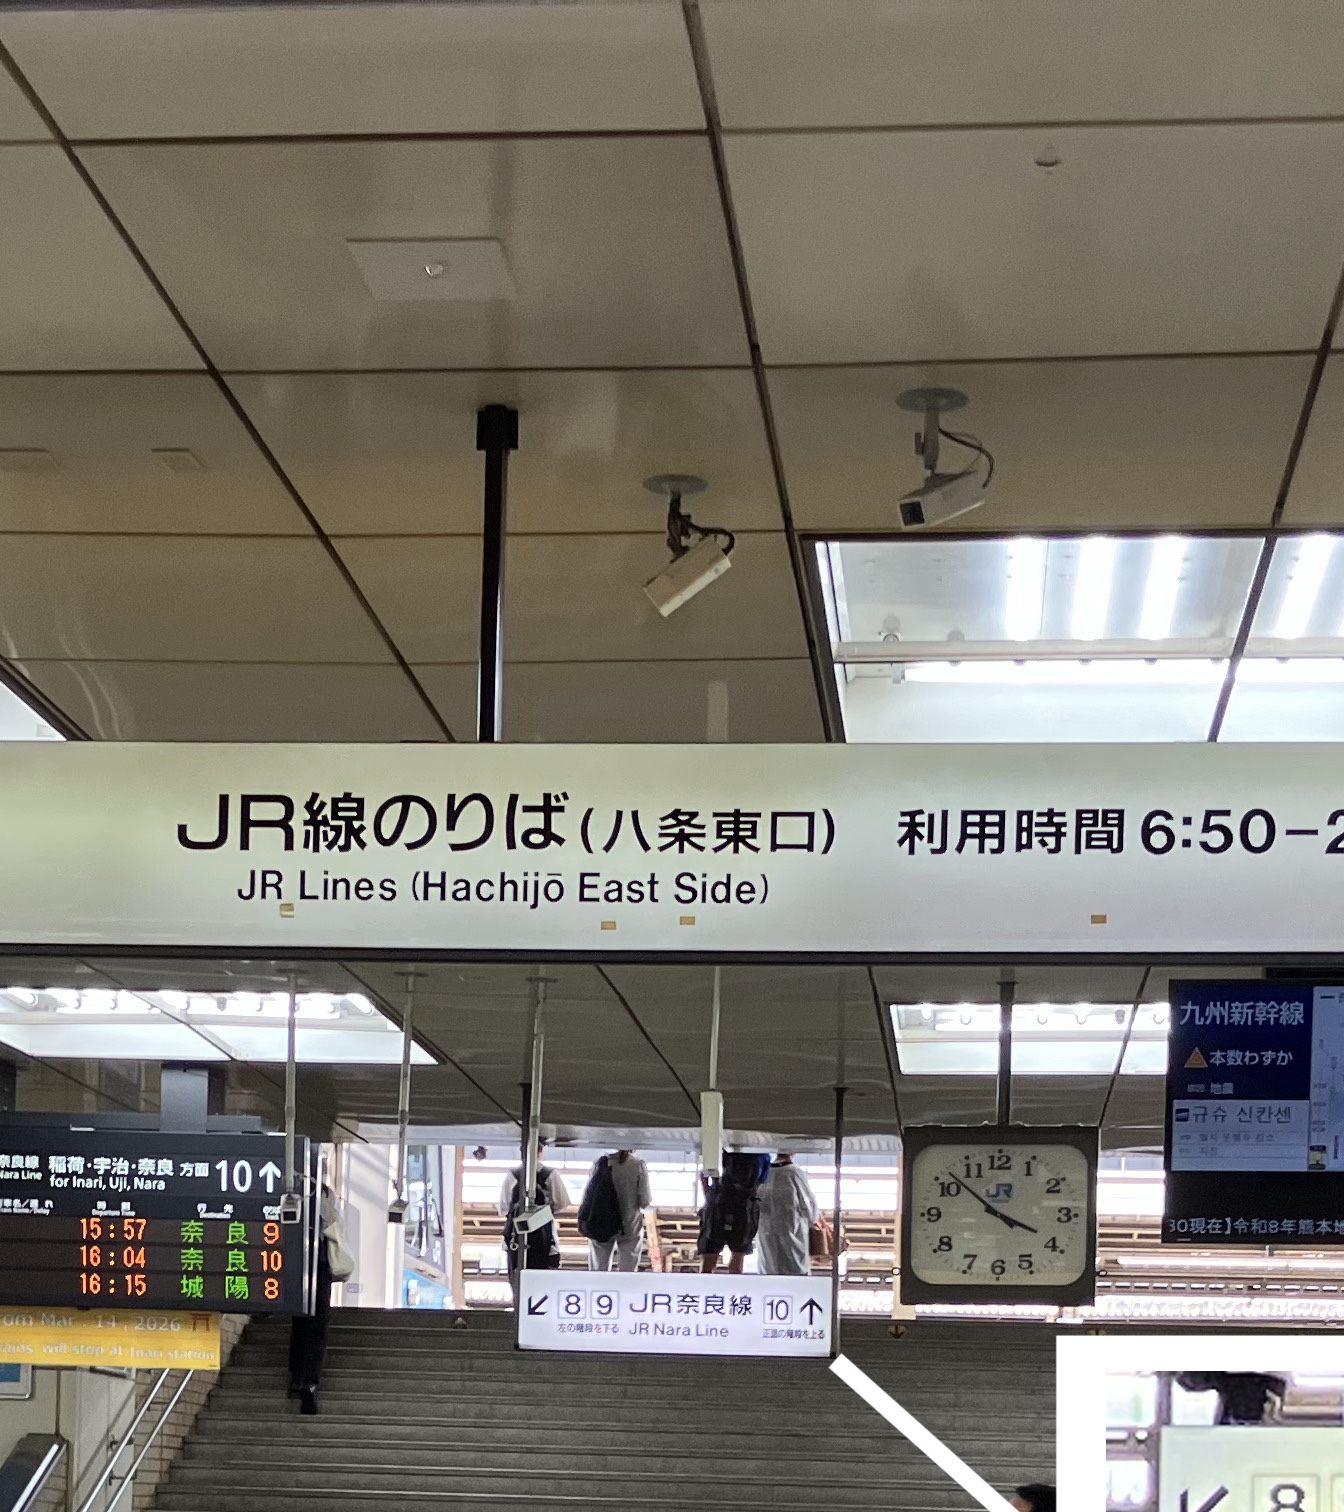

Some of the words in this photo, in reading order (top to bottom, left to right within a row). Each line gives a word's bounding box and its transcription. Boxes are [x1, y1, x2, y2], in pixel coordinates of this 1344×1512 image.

[238, 870, 283, 900] JR
[299, 871, 398, 901] Lines
[411, 870, 565, 909] (Hachijō
[578, 873, 659, 904] East
[673, 872, 769, 906] Side)
[1179, 1000, 1305, 1027] 九州新幹線
[1209, 1048, 1294, 1068] 本数わずか
[1236, 1105, 1292, 1124] 신칸센
[963, 1162, 984, 1179] 11
[988, 1154, 1012, 1171] 12
[1024, 1160, 1033, 1177] 1
[21, 1170, 43, 1182] Line
[49, 1176, 69, 1189] for
[72, 1176, 106, 1191] Inari,
[109, 1177, 131, 1193] Uji,
[134, 1178, 166, 1191] Nara
[179, 1162, 210, 1178] 方面
[216, 1159, 253, 1193] 10
[939, 1181, 962, 1197] 10
[986, 1183, 1013, 1198] JR
[1045, 1177, 1062, 1194] 2
[926, 1206, 942, 1223] 9
[1056, 1206, 1073, 1223] 3
[263, 1221, 281, 1245] 9
[937, 1235, 953, 1252] 8
[1043, 1236, 1060, 1253] 4
[261, 1250, 283, 1272] 10
[963, 1254, 978, 1270] 7
[990, 1259, 1006, 1276] 6
[1017, 1253, 1033, 1270] 5
[264, 1277, 280, 1301] 8
[565, 1293, 582, 1316] 8
[596, 1294, 613, 1316] 9
[628, 1293, 753, 1317] JR奈良線
[765, 1299, 790, 1321] 10
[134, 1315, 182, 1332] 2026
[628, 1322, 650, 1336] JR
[653, 1323, 692, 1337] Nara
[695, 1323, 730, 1338] Line
[72, 1343, 105, 1358] stop
[109, 1344, 124, 1357] at
